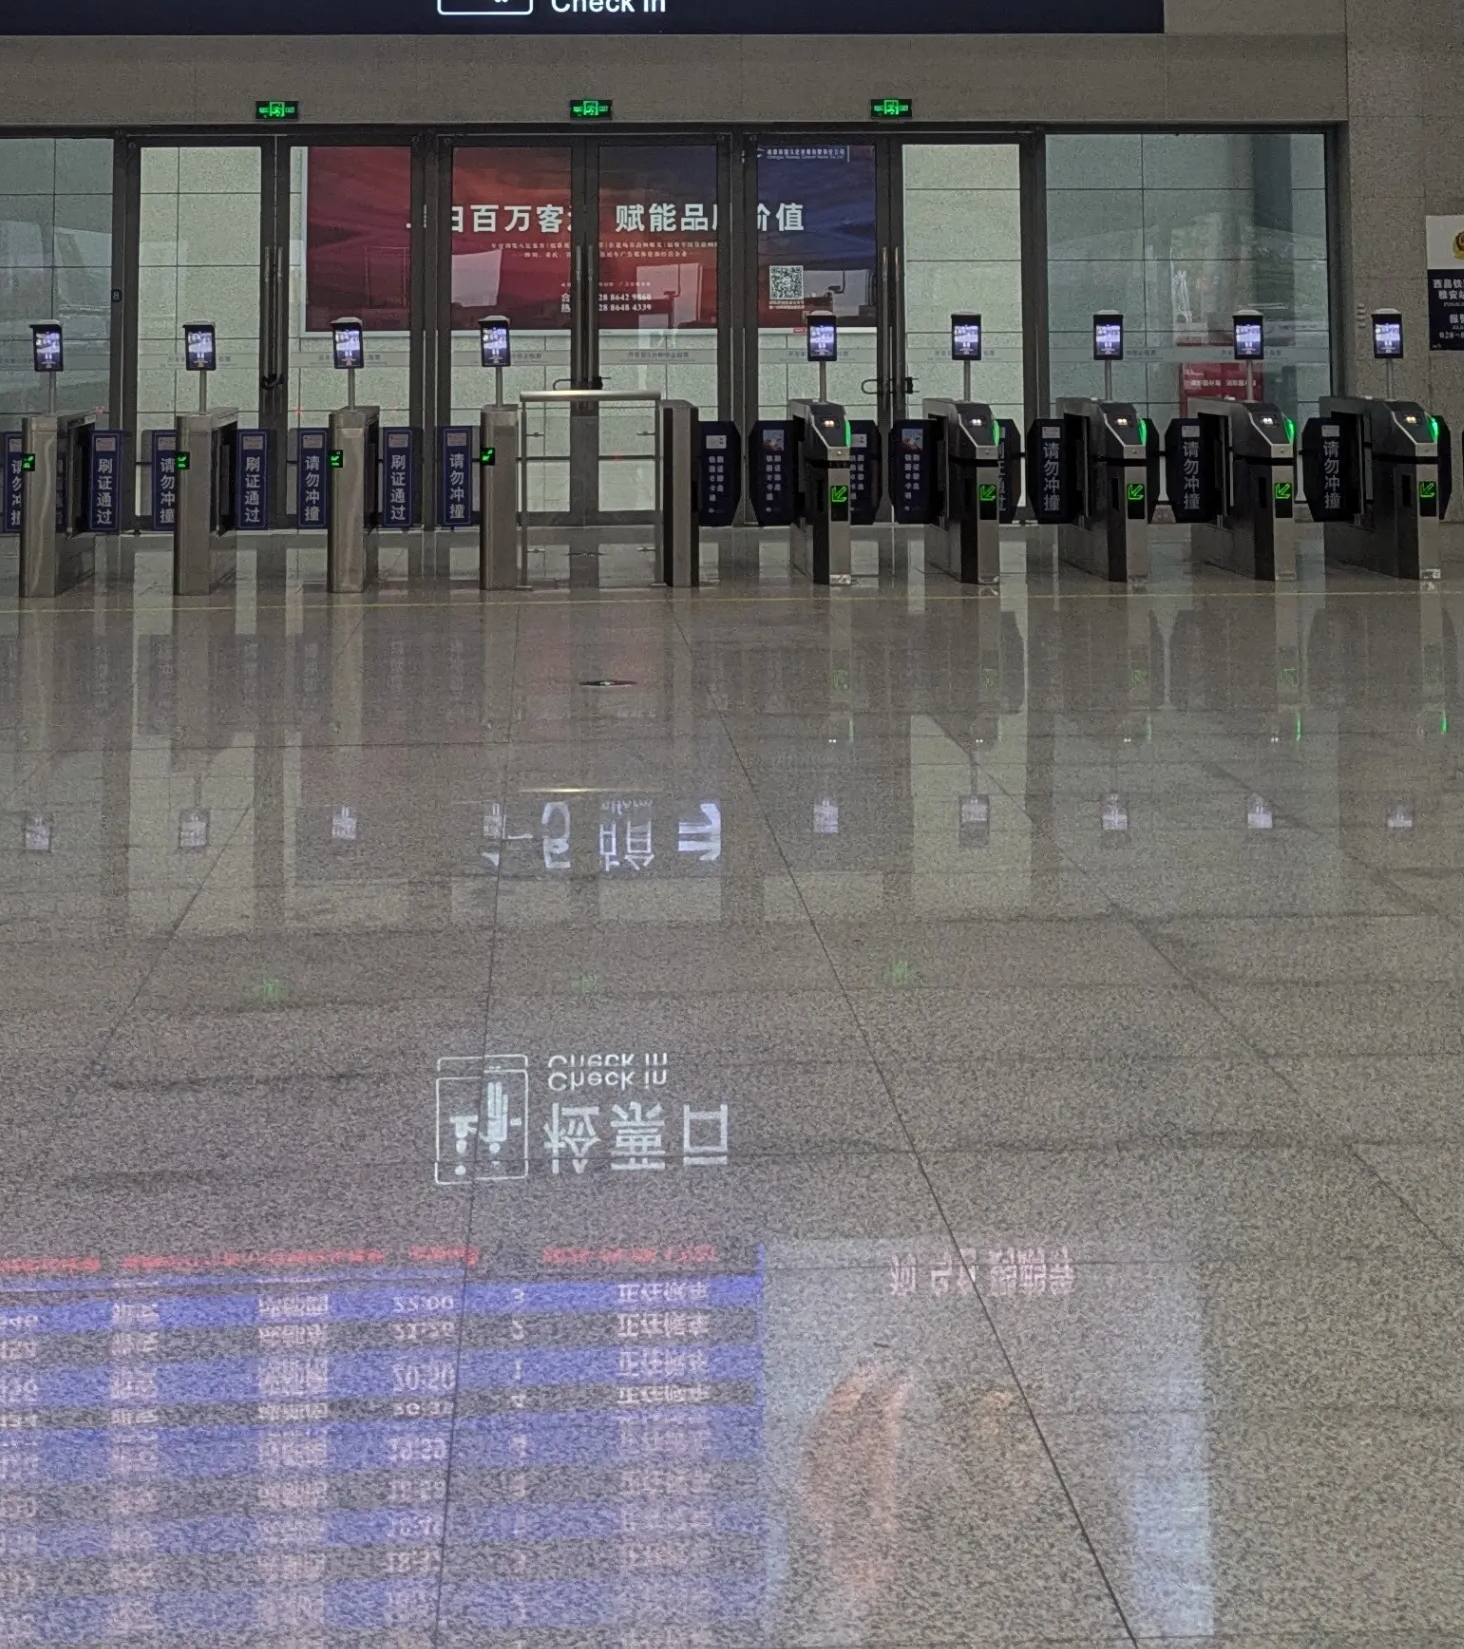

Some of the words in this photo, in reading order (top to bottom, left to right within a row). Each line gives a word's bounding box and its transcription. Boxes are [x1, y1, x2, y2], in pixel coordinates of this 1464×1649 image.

[97, 458, 113, 525] 刷证通过
[160, 457, 175, 524] 请勿冲撞
[244, 457, 261, 523] 刷证通过
[305, 456, 321, 522] 请勿冲撞
[390, 455, 407, 521] 刷证通过
[449, 454, 466, 520] 请勿冲撞
[1044, 442, 1060, 511] 请勿冲撞
[1183, 441, 1200, 510] 请勿冲撞
